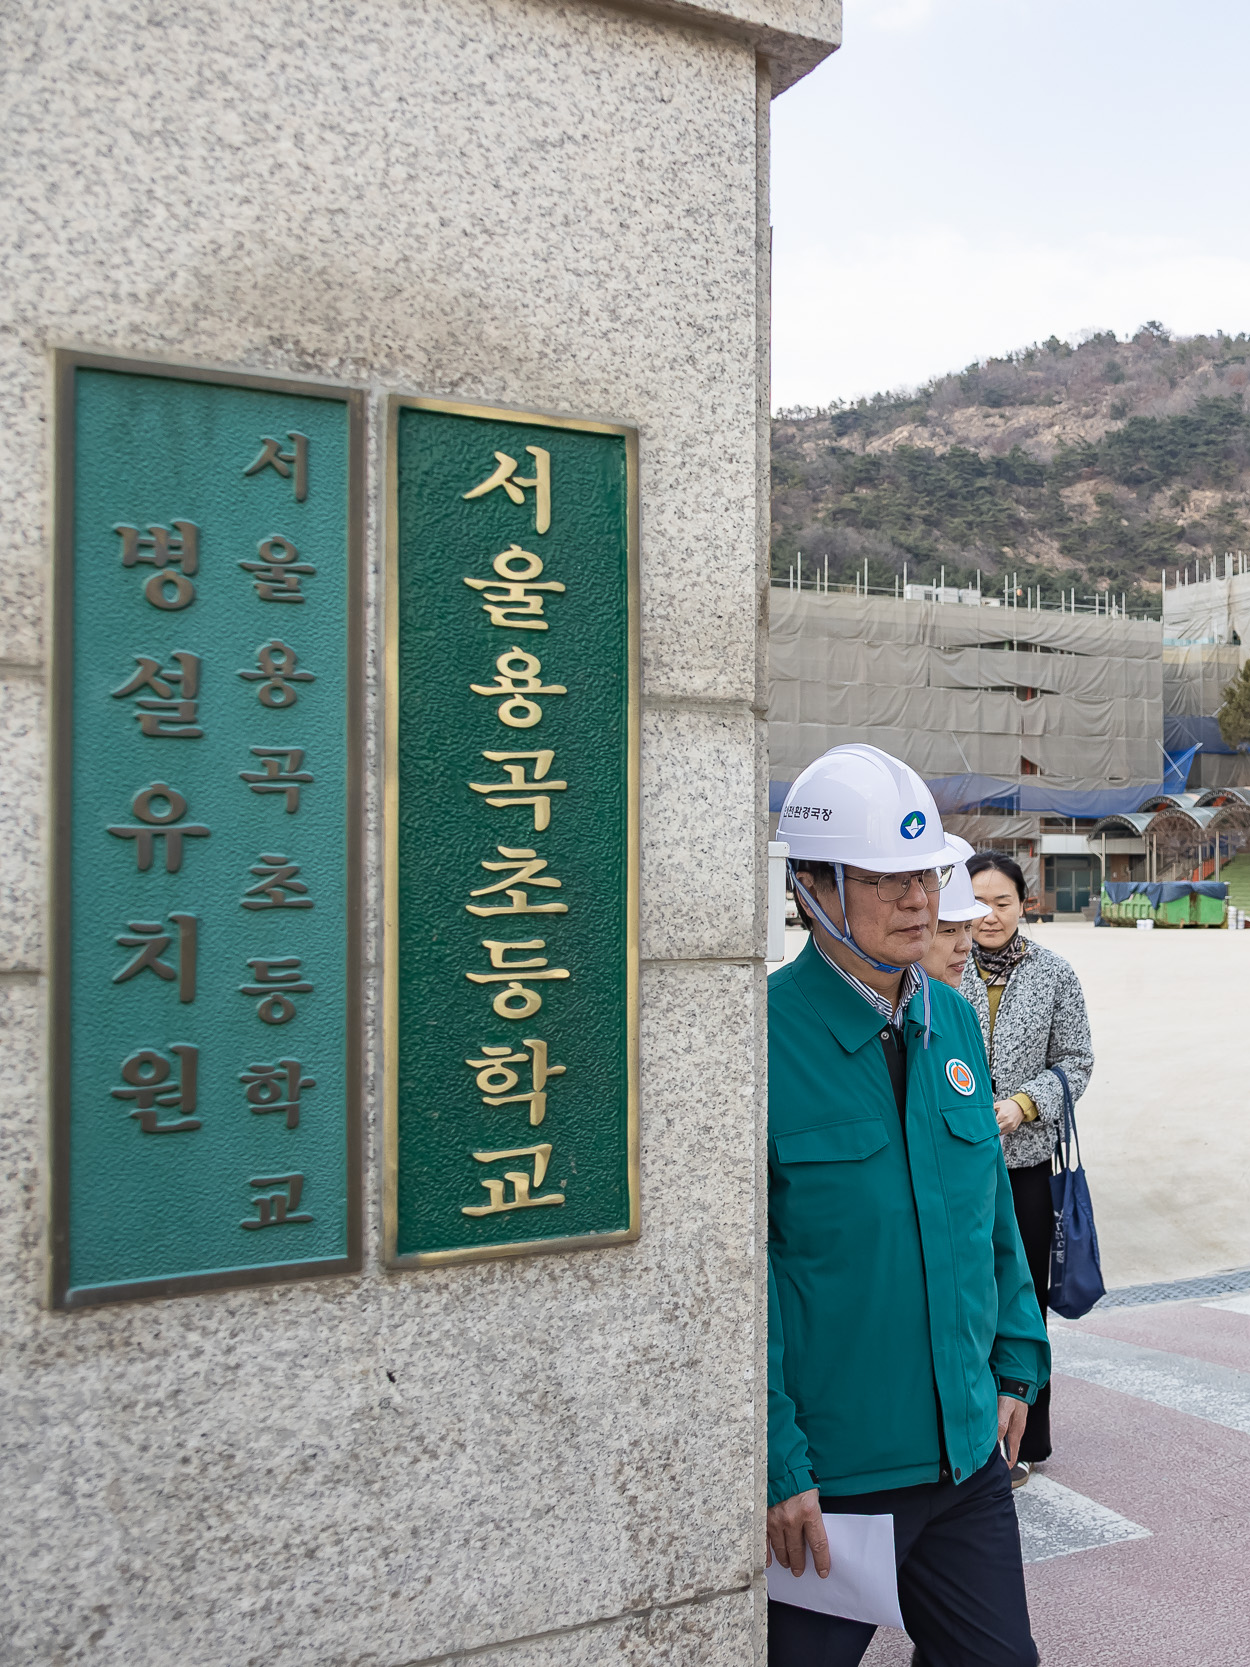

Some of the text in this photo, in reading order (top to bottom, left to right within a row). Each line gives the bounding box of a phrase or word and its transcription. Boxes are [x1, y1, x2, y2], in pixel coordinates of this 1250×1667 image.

[107, 519, 211, 1135] 병설유치원
[237, 429, 316, 1232] 서울용곡초등학교
[461, 444, 568, 1219] 서울용곡초등학교
